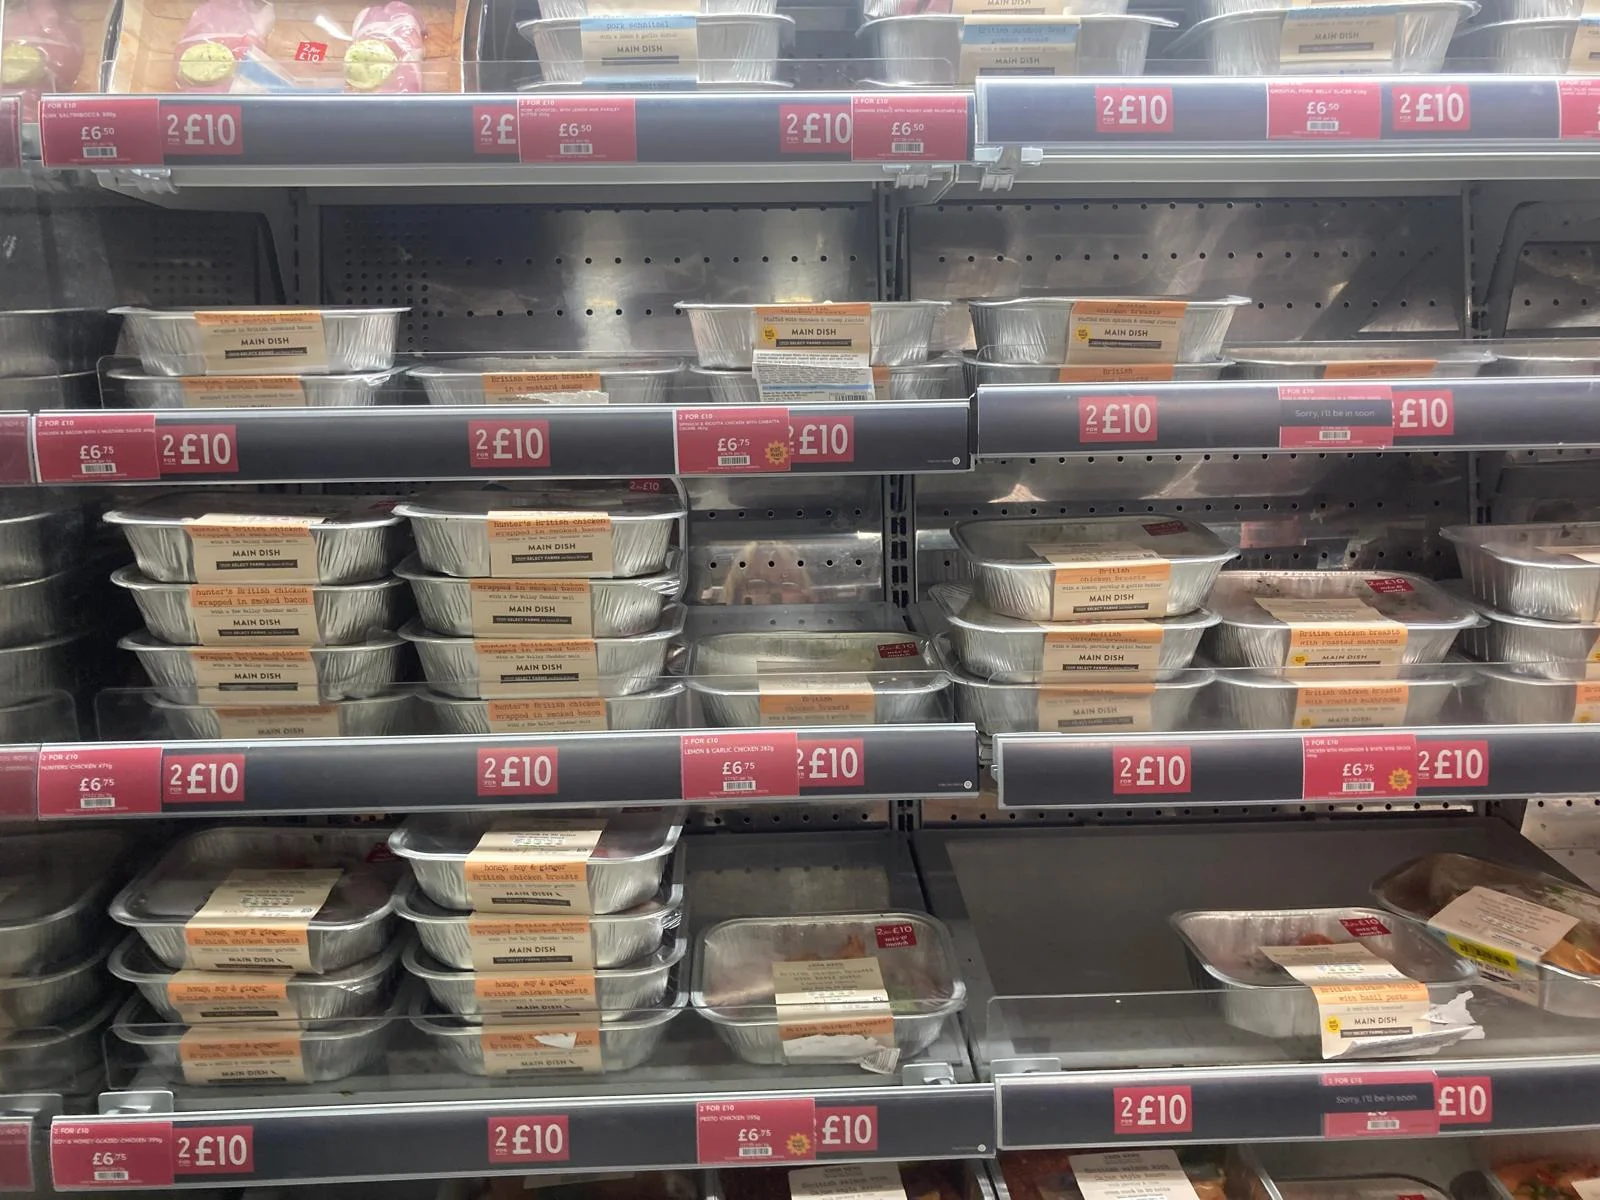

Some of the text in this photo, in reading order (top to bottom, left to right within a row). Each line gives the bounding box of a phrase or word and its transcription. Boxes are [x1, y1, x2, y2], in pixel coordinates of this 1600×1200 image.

[1314, 31, 1360, 41] MAIN DISH
[299, 51, 320, 63] £10
[617, 45, 663, 54] MAIN DISH
[995, 57, 1017, 65] MAIN
[1103, 94, 1168, 125] 2 £10
[1306, 101, 1340, 115] £6.50
[1399, 92, 1464, 123] 2 £10
[167, 114, 236, 146] 2 £10
[480, 114, 492, 136] 2
[558, 123, 592, 138] £6.50
[786, 112, 851, 144] 2 £10
[891, 122, 925, 136] £6.50
[81, 126, 115, 141] £6.50
[791, 328, 837, 336] MAIN DISH
[1104, 328, 1149, 337] MAIN DISH
[241, 337, 290, 346] MAIN DISH
[1085, 402, 1152, 434] 2 £10
[1295, 409, 1320, 419] Sorry,
[1332, 409, 1344, 417] be
[1345, 409, 1353, 417] in
[1399, 397, 1448, 428] £10
[475, 427, 544, 459] 2 £10
[717, 437, 750, 451] £6.75
[799, 423, 849, 455] £10
[80, 445, 114, 460] £6.75
[162, 432, 232, 465] 2 £10
[629, 481, 636, 490] 2
[528, 542, 576, 551] MAIN DISH
[1089, 594, 1112, 602] MAIN
[508, 605, 556, 613] MAIN DISH
[259, 618, 281, 626] DISH
[516, 663, 563, 672] MAIN DISH
[260, 672, 282, 680] DISH
[48, 753, 64, 761] FOR
[808, 747, 858, 779] £10
[1418, 748, 1484, 780] 2 £10
[484, 755, 552, 787] 2 £10
[722, 761, 756, 776] £6.75
[1120, 755, 1186, 786] 2 £10
[1342, 762, 1375, 777] £6.75
[79, 777, 115, 792] £6.75
[170, 762, 239, 795] 2 £10
[539, 863, 567, 872] ginger
[892, 926, 912, 934] £10
[508, 945, 556, 954] MAIN DISH
[1378, 1016, 1398, 1024] DISH
[1336, 1095, 1362, 1105] Sorry,
[1374, 1094, 1385, 1103] be
[1396, 1094, 1418, 1102] soon
[1438, 1085, 1487, 1116] £10
[1121, 1094, 1187, 1125] 2 £10
[737, 1127, 772, 1142] £6.75
[821, 1113, 873, 1145] £10
[495, 1123, 563, 1155] 2 £10
[178, 1134, 247, 1166] 2 £10
[92, 1151, 128, 1166] £6.75
